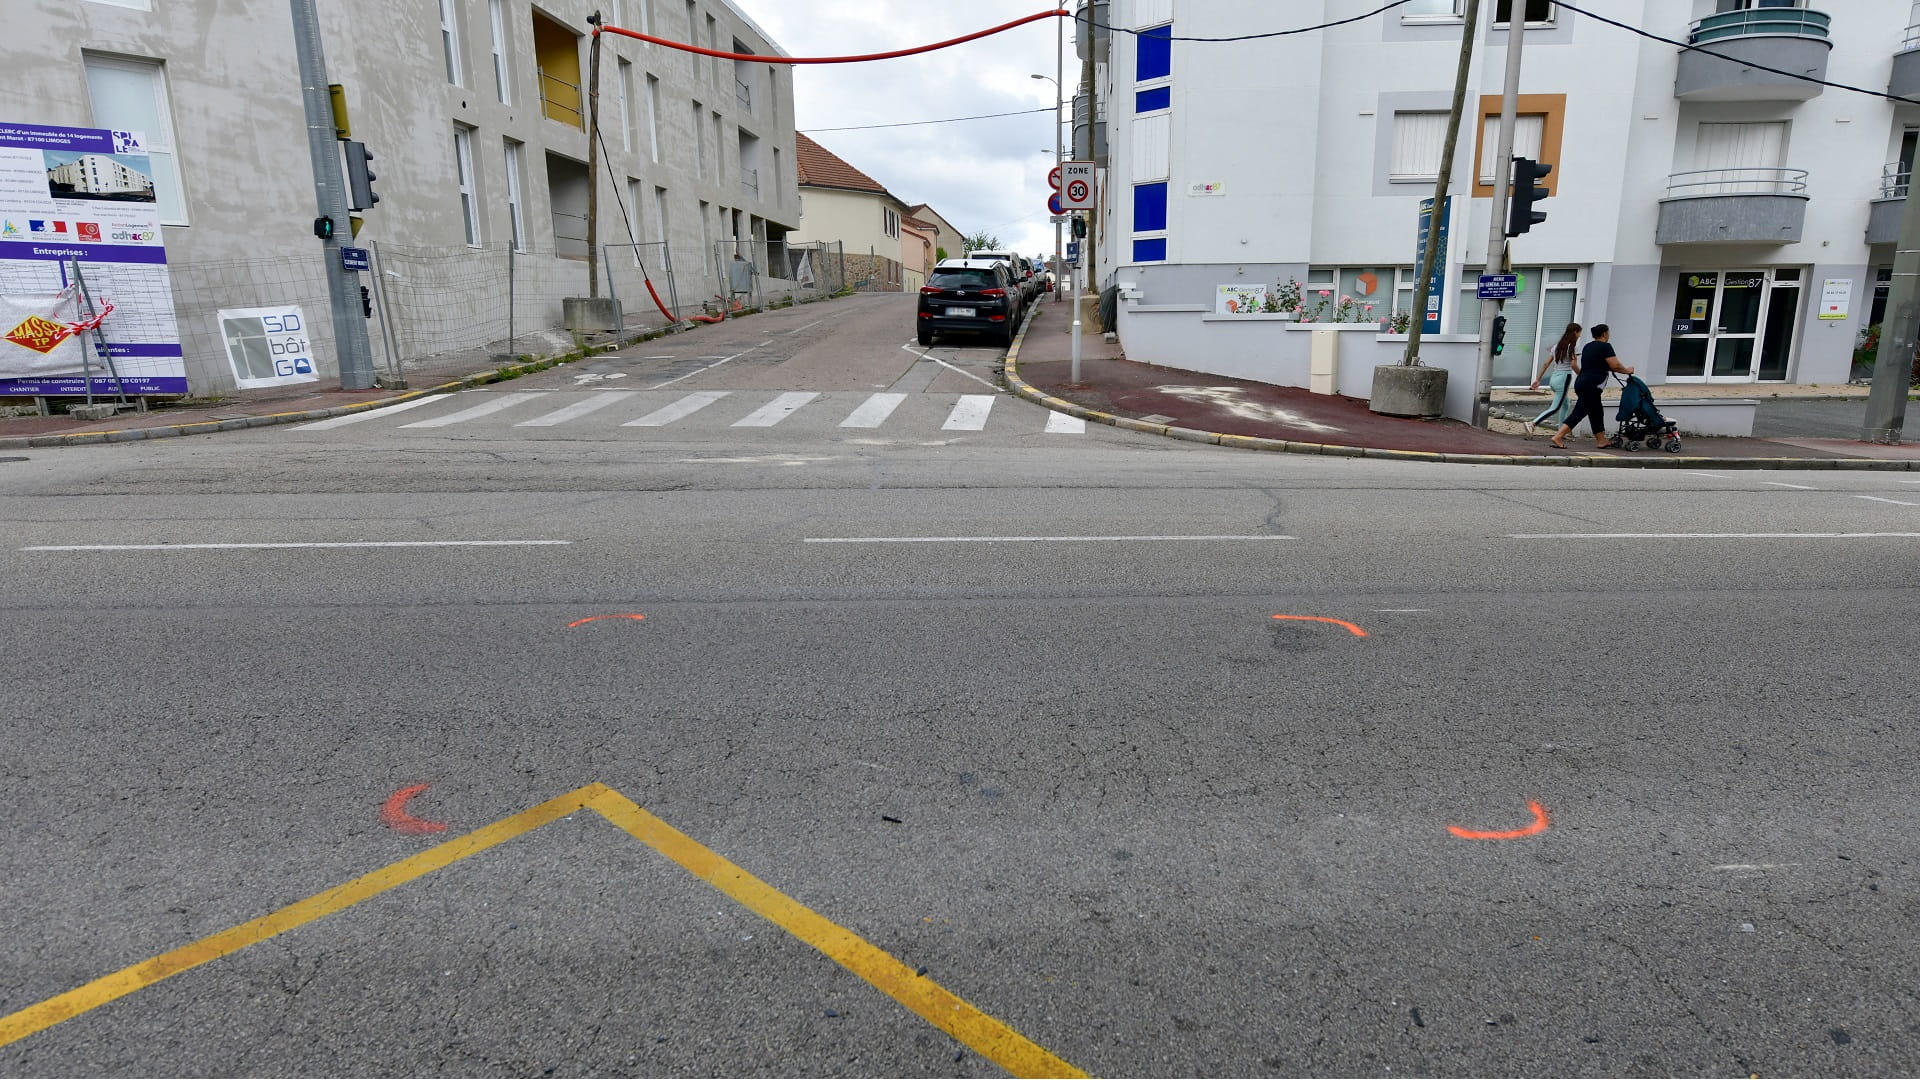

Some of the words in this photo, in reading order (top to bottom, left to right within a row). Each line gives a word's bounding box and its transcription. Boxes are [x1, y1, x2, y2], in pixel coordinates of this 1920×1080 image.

[1072, 186, 1084, 196] 30
[112, 231, 154, 240] odhac87
[33, 248, 84, 256] Entreprises
[263, 314, 300, 332] SD
[13, 317, 62, 340] MASSY
[32, 338, 50, 346] TP
